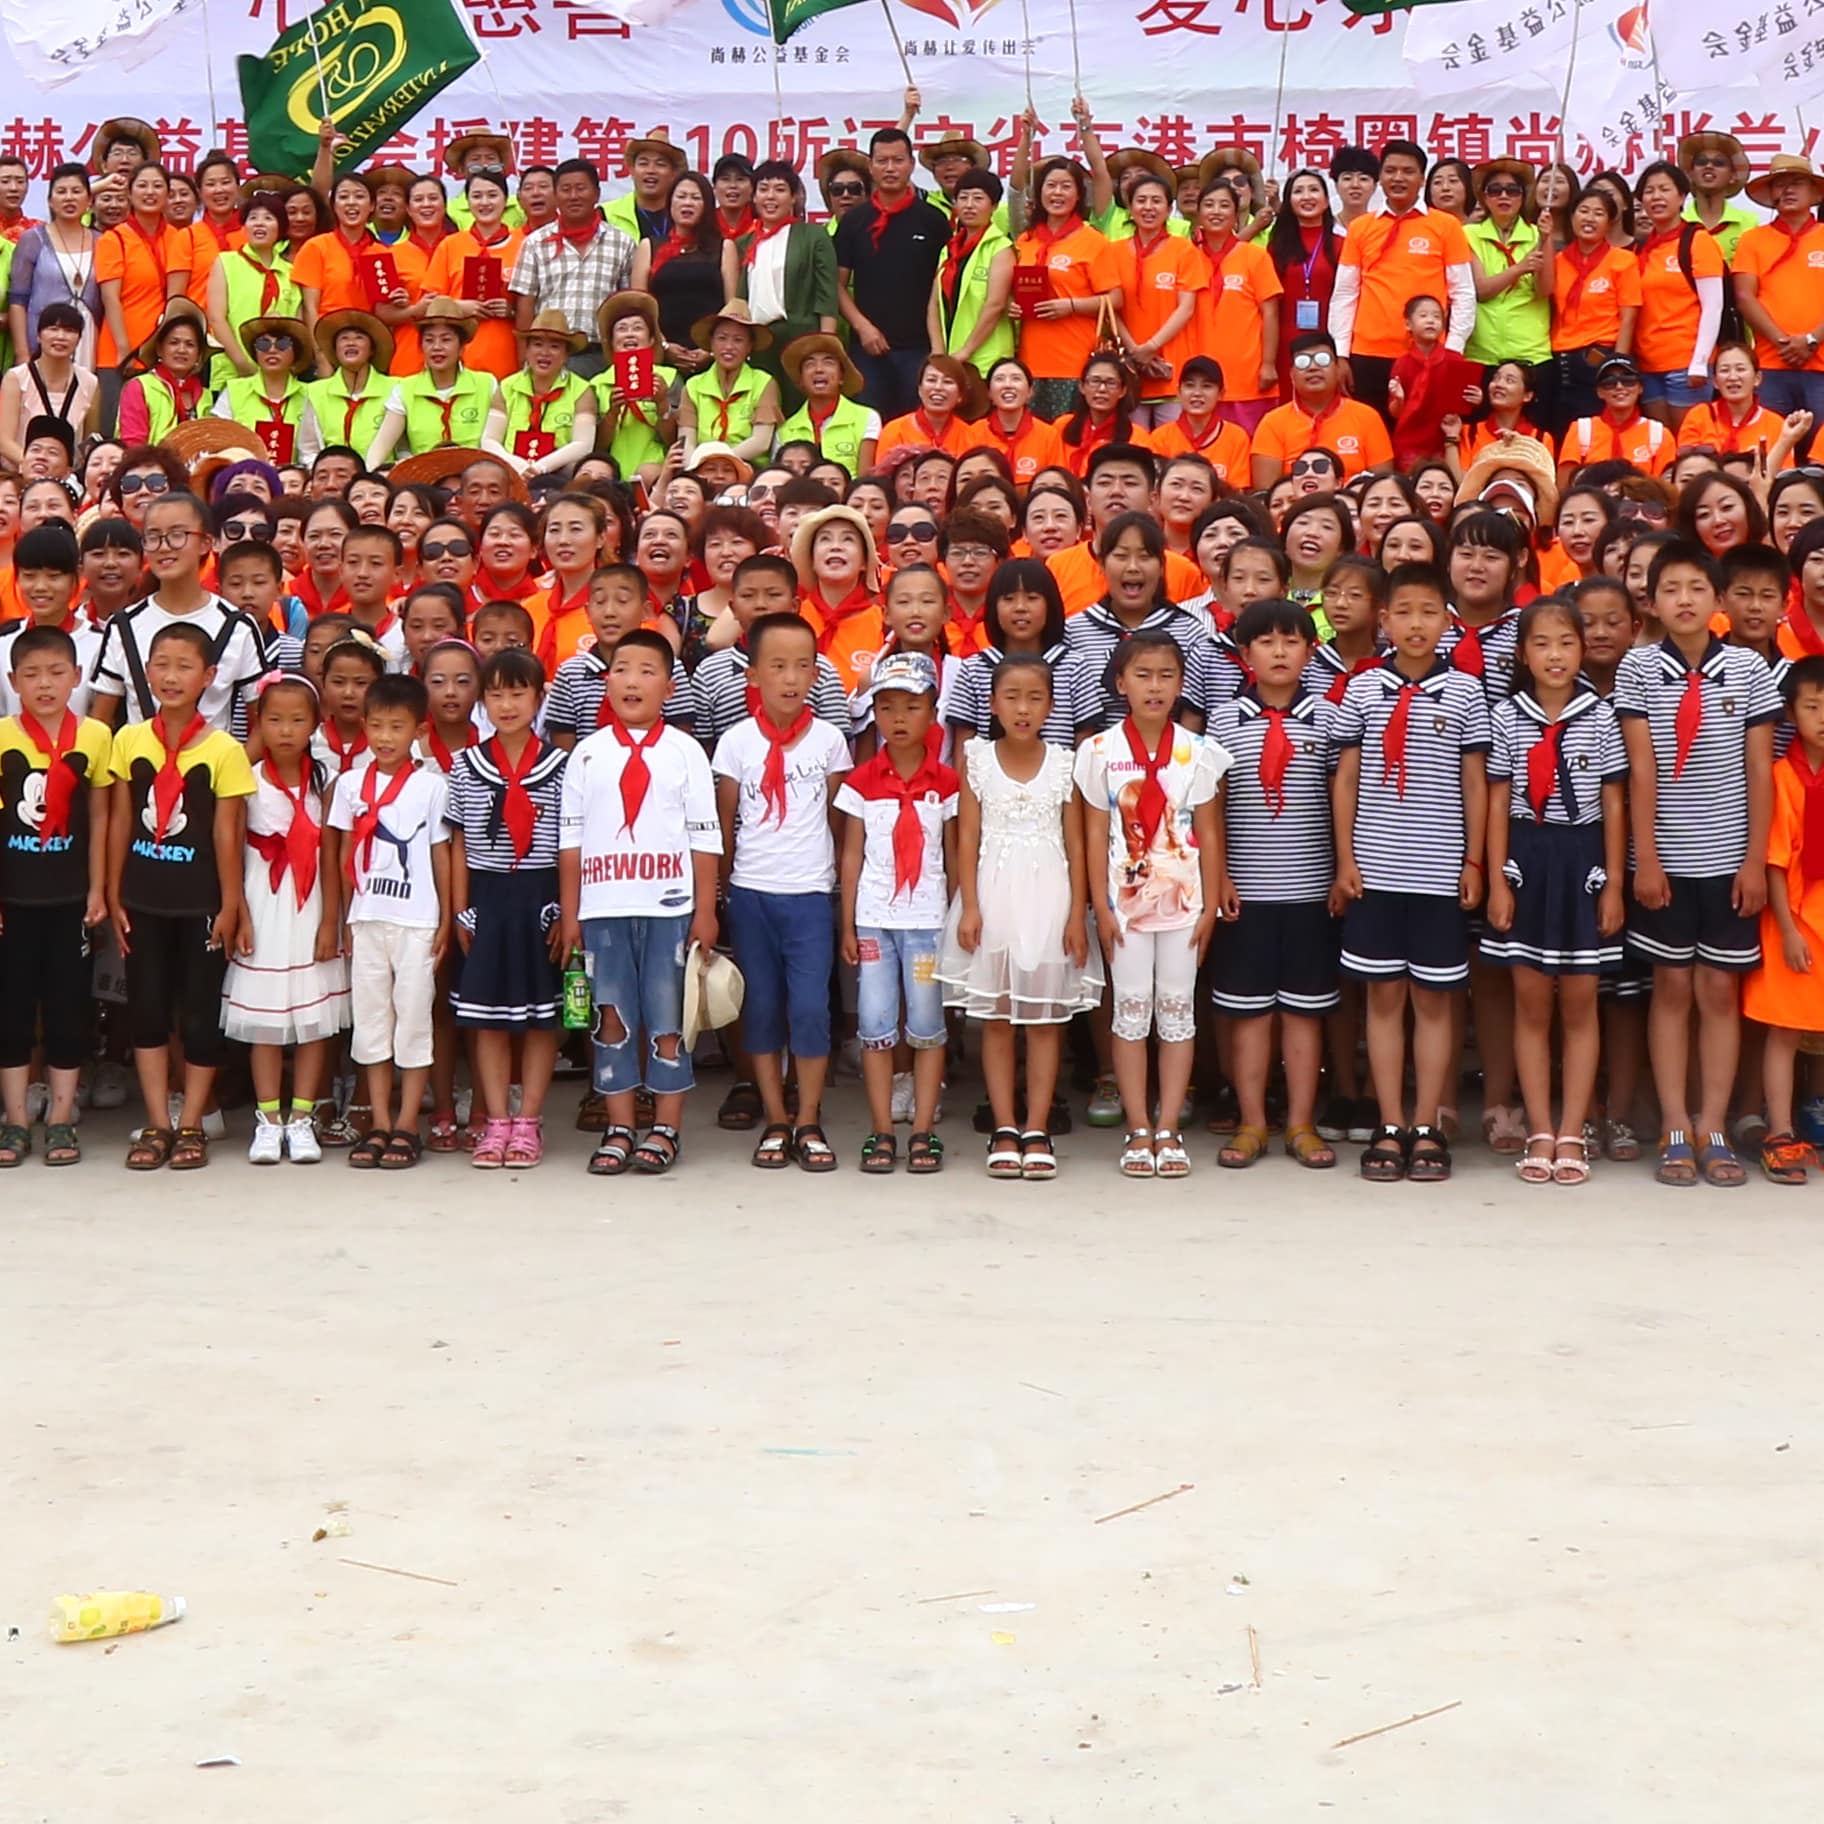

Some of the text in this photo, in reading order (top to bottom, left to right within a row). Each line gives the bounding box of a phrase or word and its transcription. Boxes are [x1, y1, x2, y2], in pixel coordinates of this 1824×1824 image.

[710, 45, 851, 64] 尚赫公益基金会
[8, 834, 74, 852] MICKEY
[132, 839, 196, 862] MICKEY
[582, 851, 684, 886] FIREWORK
